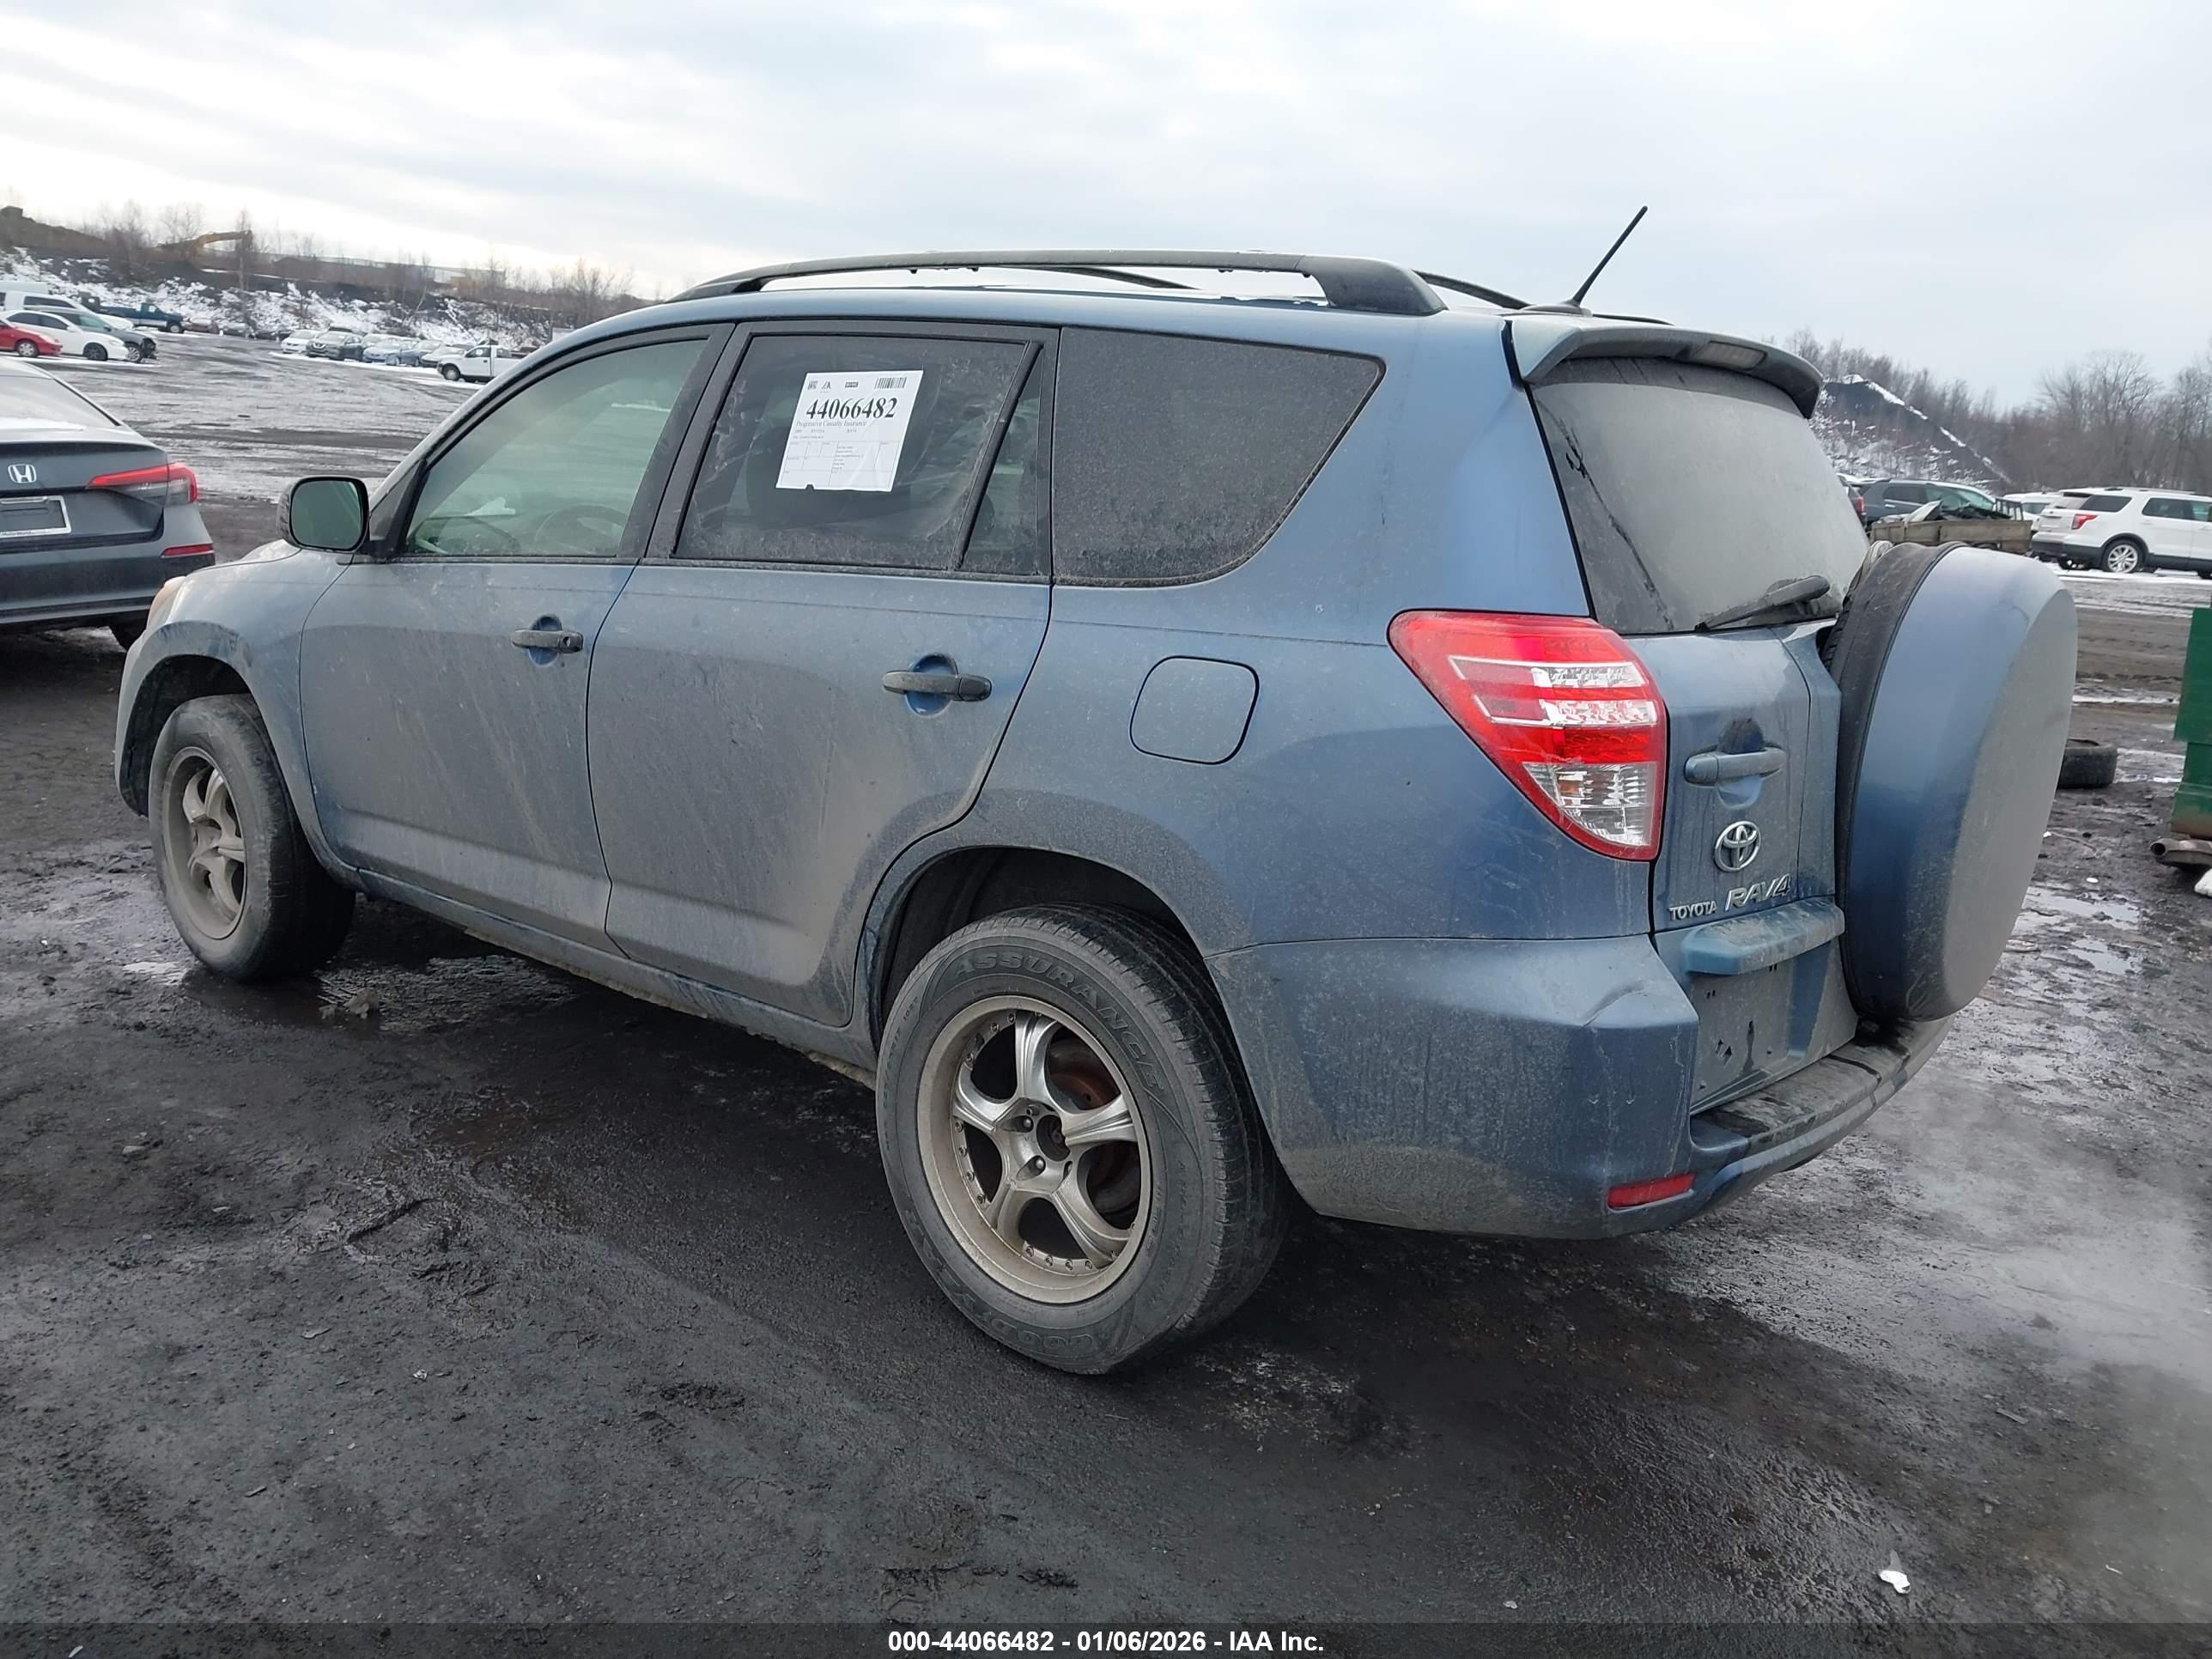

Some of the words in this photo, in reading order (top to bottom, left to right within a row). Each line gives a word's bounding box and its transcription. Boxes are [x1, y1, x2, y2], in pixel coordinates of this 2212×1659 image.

[805, 397, 897, 420] 44066482
[1669, 900, 1717, 921] TOYOTA
[1724, 873, 1791, 912] RAV4
[954, 951, 1164, 1091] ASSURANCE
